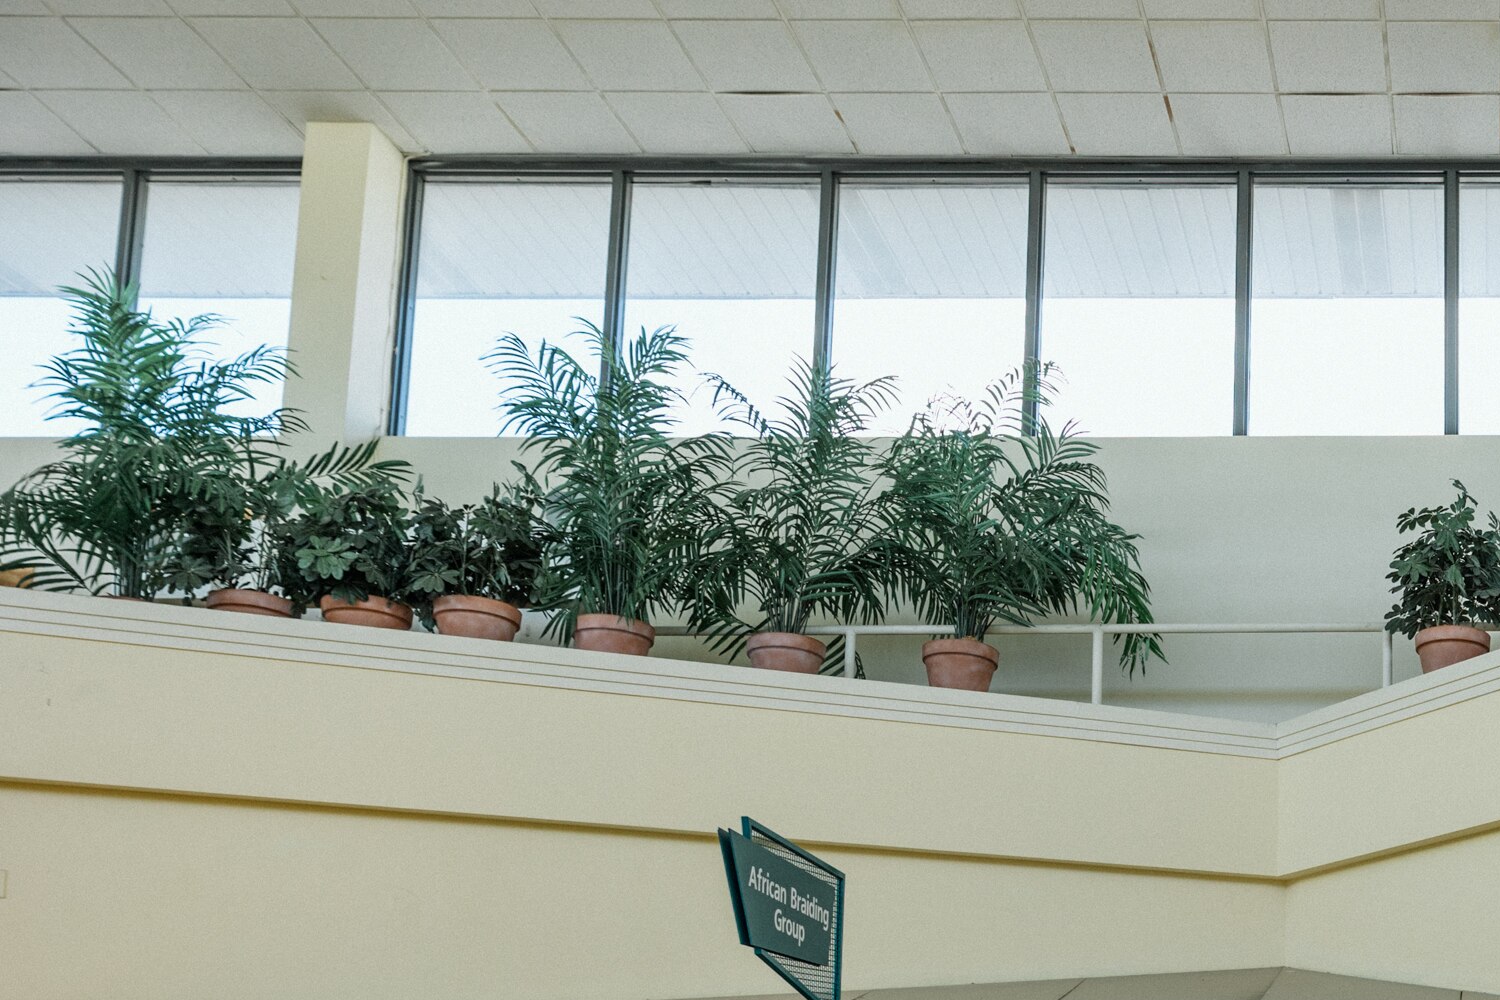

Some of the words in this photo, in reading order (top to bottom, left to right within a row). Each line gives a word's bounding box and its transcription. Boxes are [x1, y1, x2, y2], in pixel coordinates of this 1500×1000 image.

[748, 866, 787, 905] African
[790, 886, 830, 931] Braiding
[774, 909, 805, 946] Group
